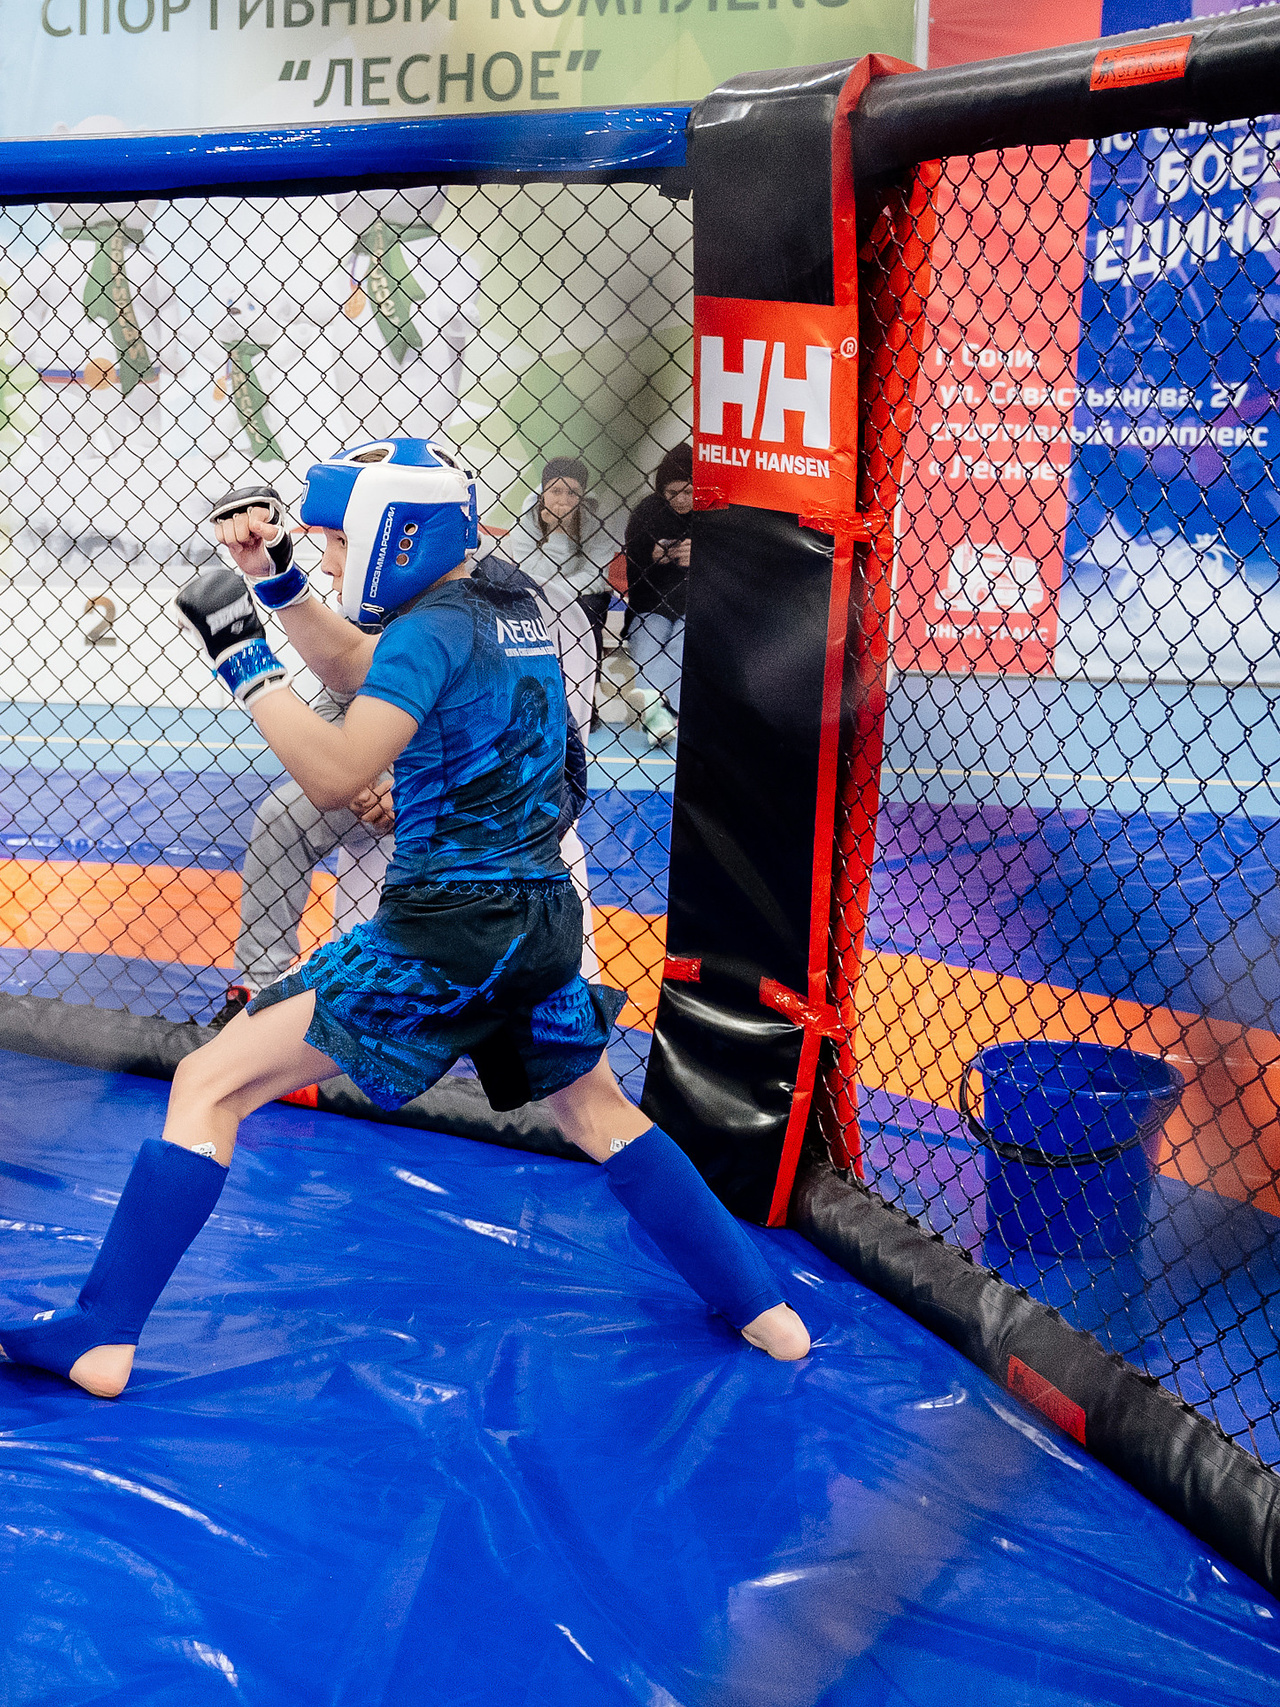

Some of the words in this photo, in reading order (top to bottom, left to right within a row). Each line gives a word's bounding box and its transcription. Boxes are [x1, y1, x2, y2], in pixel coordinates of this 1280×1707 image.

[699, 335, 833, 450] HH
[1209, 381, 1250, 408] 27
[698, 442, 751, 468] HELLY
[755, 450, 831, 479] HANSEN
[84, 596, 117, 647] 2
